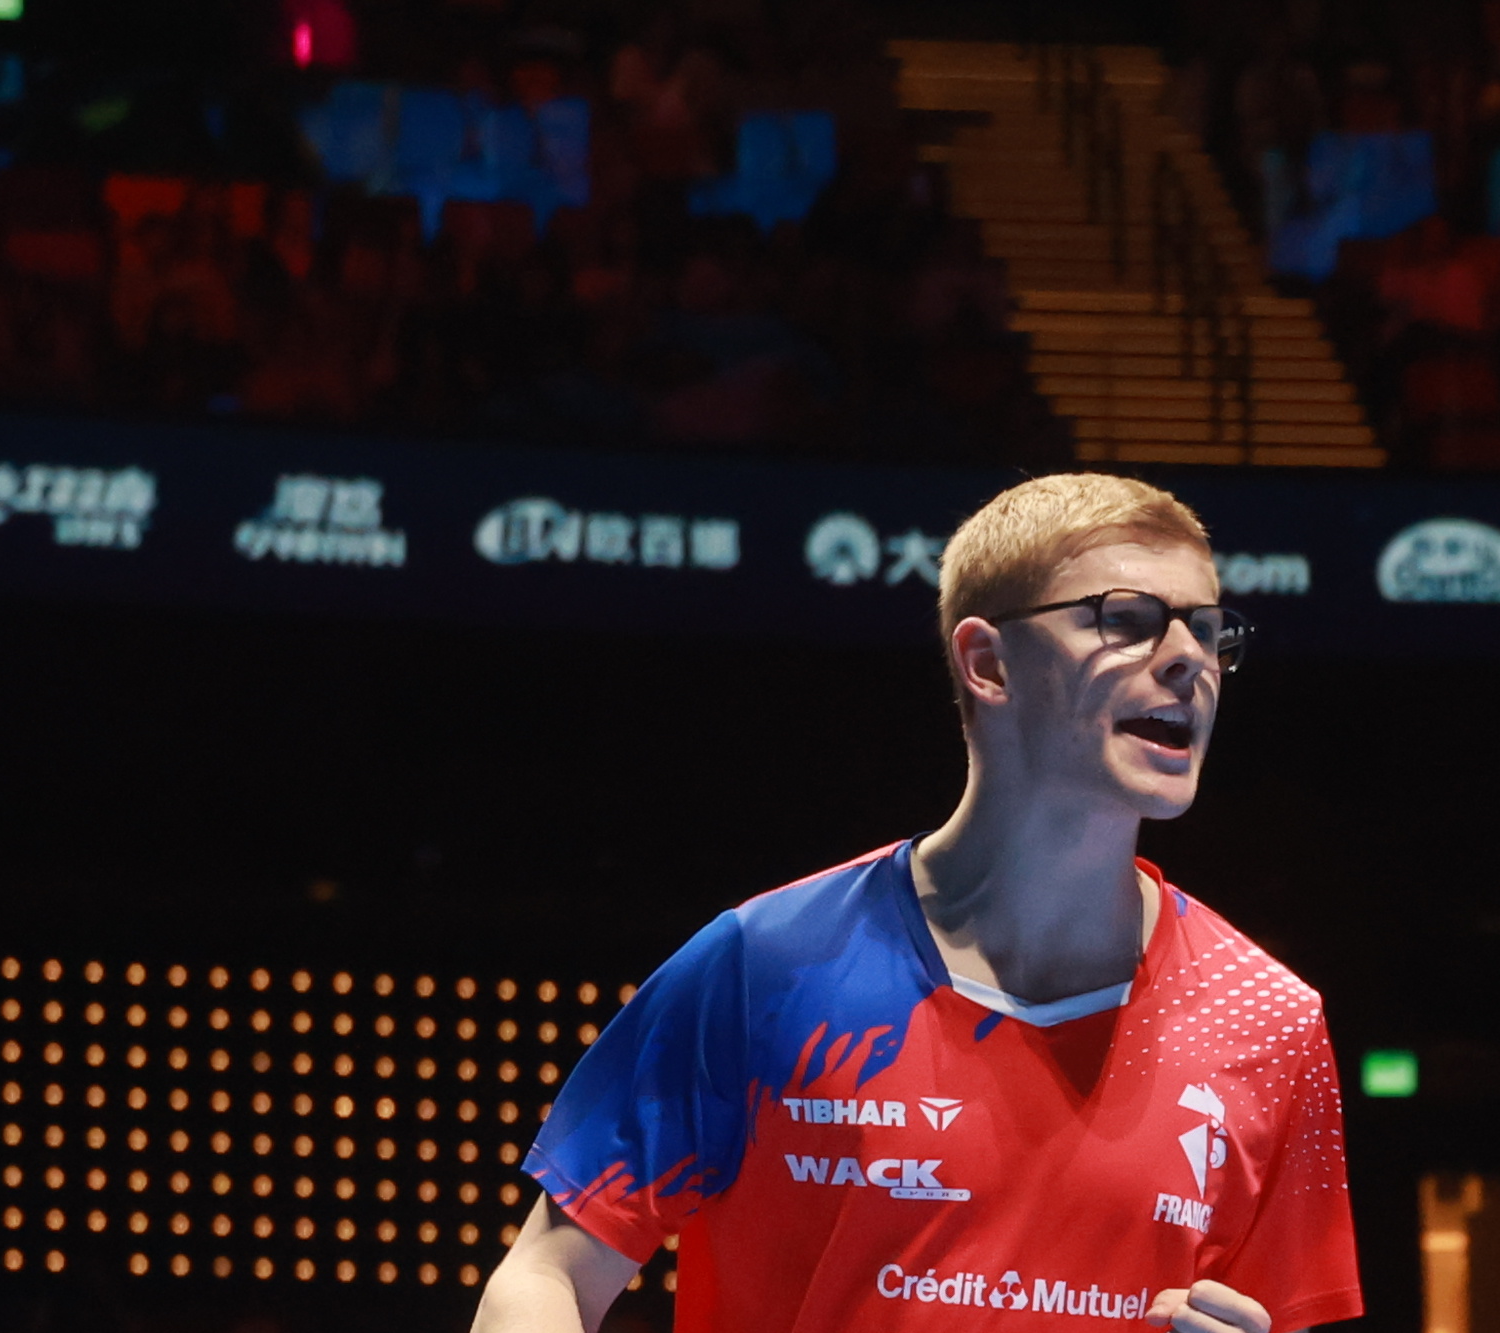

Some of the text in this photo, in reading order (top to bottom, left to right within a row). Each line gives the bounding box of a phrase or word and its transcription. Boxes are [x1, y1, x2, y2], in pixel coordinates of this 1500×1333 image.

[783, 1097, 906, 1127] TIBHAR
[784, 1154, 942, 1188] WACK
[1153, 1192, 1214, 1235] FRANC
[877, 1264, 1149, 1320] Crédit Mutuel
